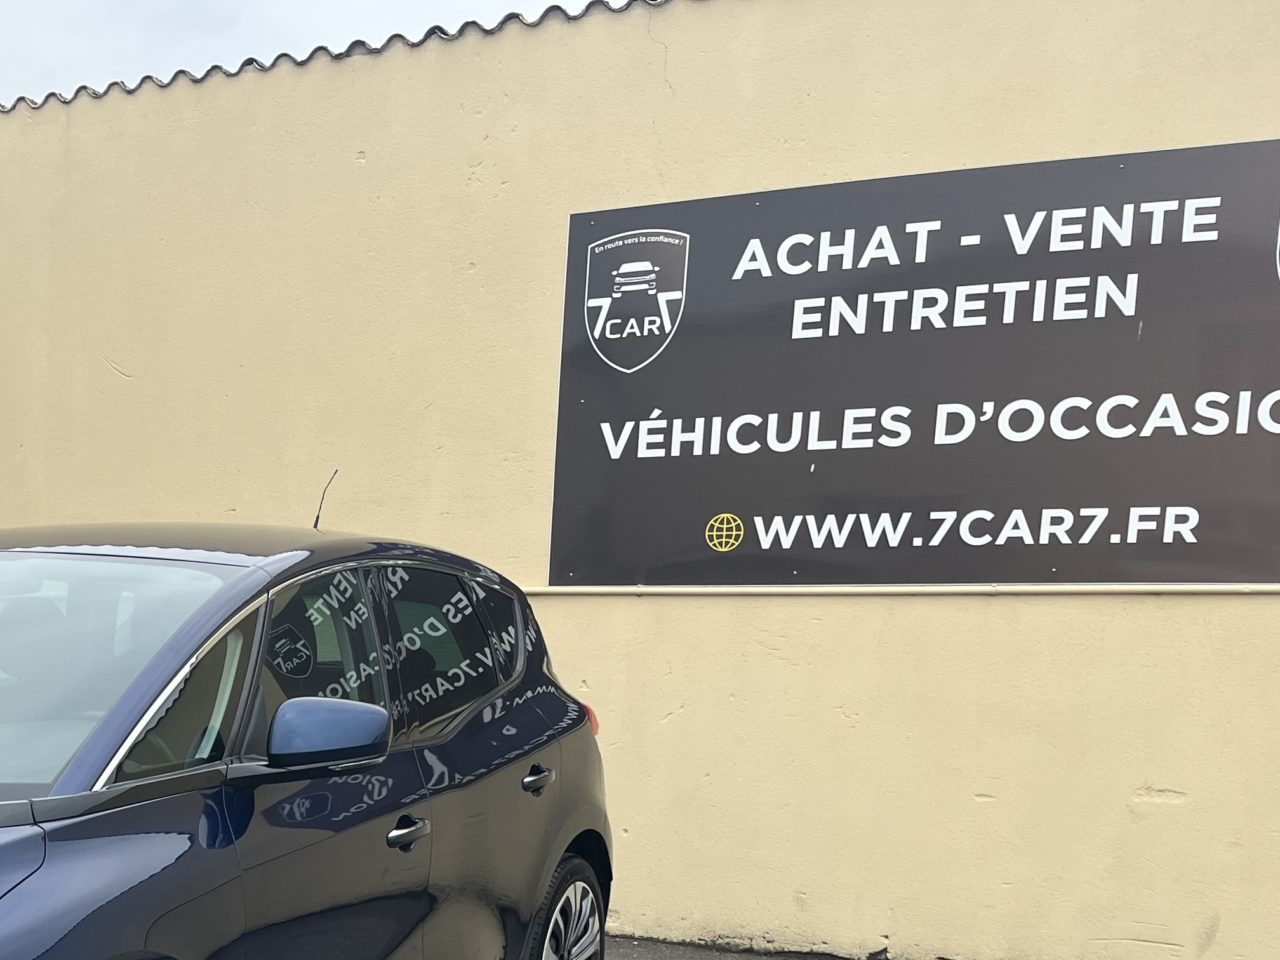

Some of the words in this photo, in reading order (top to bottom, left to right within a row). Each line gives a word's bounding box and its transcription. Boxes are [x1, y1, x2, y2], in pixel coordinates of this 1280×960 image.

[594, 246, 604, 254] En
[604, 239, 623, 250] route
[624, 236, 638, 245] vers
[647, 235, 679, 245] confiance
[732, 220, 942, 280] ACHAT
[1004, 196, 1222, 257] VENTE
[791, 273, 1140, 340] ENTRETIEN
[600, 407, 913, 460] VÉHICULES
[753, 506, 1200, 550] WWW.7CAR7.FR
